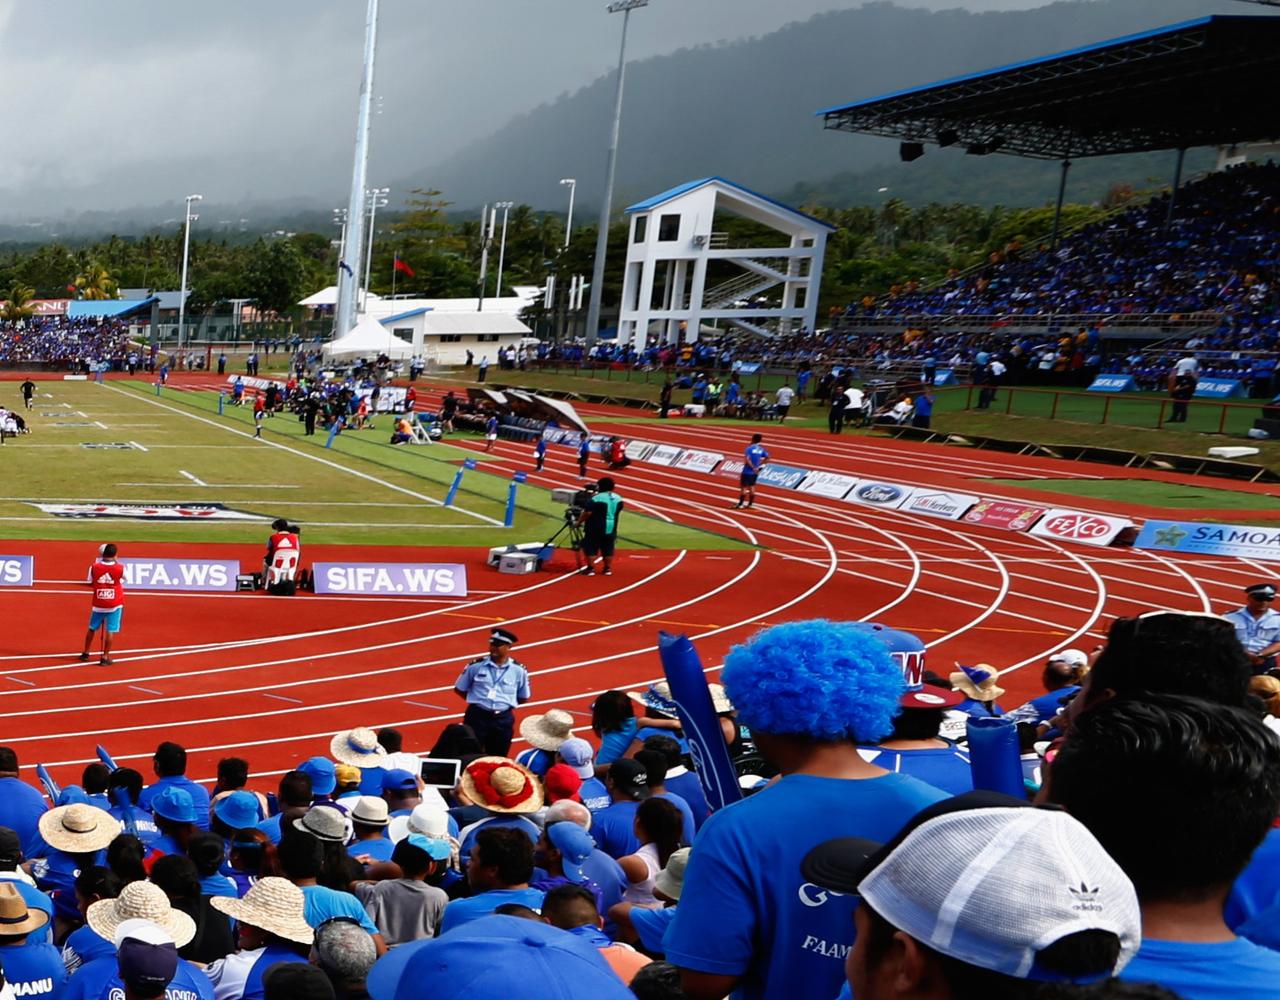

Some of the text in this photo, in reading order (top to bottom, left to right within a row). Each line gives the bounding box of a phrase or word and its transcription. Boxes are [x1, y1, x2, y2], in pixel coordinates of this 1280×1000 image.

[863, 484, 895, 501] Ford
[1049, 514, 1109, 539] FEXCO
[125, 563, 228, 590] IFA.WS
[326, 567, 455, 593] SIFA.WS
[1072, 902, 1102, 912] adidas
[12, 977, 53, 997] MANU
